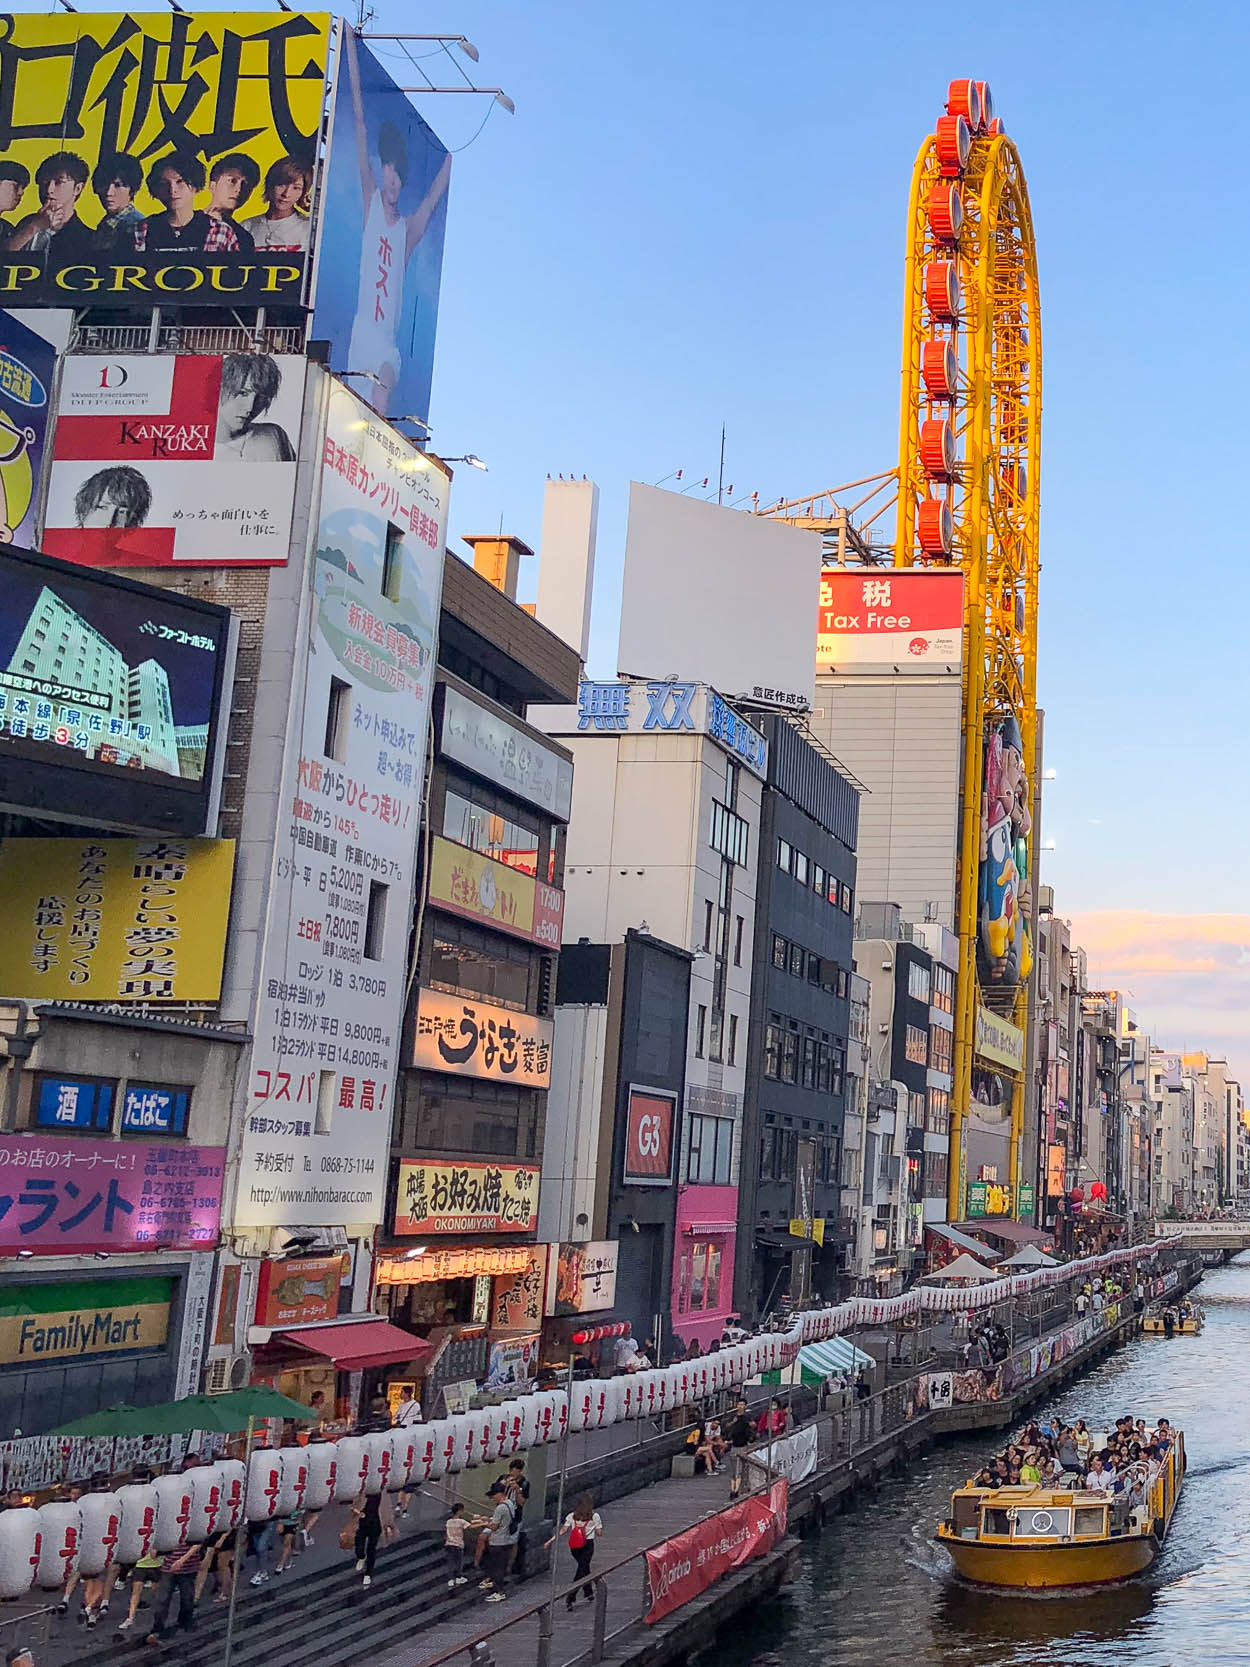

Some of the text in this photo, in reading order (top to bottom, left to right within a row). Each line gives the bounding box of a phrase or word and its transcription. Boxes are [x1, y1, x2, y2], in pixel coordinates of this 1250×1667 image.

[55, 264, 301, 292] GROUP
[118, 421, 209, 445] KANZAKI
[152, 438, 208, 457] RUKA
[323, 438, 439, 550] 日本原カンツリー倶楽部
[172, 508, 270, 521] めっちゃ面白いを
[240, 523, 280, 536] 仕事に。
[825, 612, 911, 629] Tax Free
[158, 624, 216, 651] ファーストホテル
[344, 639, 371, 673] 入会金
[577, 682, 697, 730] 無双
[752, 686, 807, 703] 意匠作成中
[330, 865, 364, 896] 5,200円
[68, 845, 107, 985] あなたのお店づくり
[540, 888, 560, 912] 17:00
[30, 895, 66, 974] 応援します
[119, 842, 188, 998] 素晴らしい夢の実現
[297, 914, 360, 945] 土日祝 7,800円
[299, 962, 387, 998] ロッジ 1泊 3,780円
[320, 1016, 339, 1037] 平日
[438, 1006, 521, 1074] うなぎ
[317, 1042, 336, 1063] 平日
[522, 1038, 549, 1074] 菱富
[56, 1085, 79, 1122] 酒
[254, 1070, 388, 1111] コスパ 最高!
[124, 1092, 169, 1126] たばこ
[249, 1116, 311, 1137] 幹部スタッフ募集
[638, 1115, 660, 1156] G3
[254, 1152, 295, 1173] 予約受付
[321, 1156, 375, 1173] 0868-75-1144
[406, 1169, 425, 1197] 本場
[429, 1167, 502, 1214] お好み焼
[0, 1178, 135, 1235] ラント
[409, 1195, 428, 1224] 大阪
[502, 1191, 531, 1226] たこ焼
[434, 1216, 497, 1231] OKONOMIYAKI
[526, 1258, 541, 1319] お好み焼
[19, 1312, 141, 1353] FamilyMart
[931, 1381, 950, 1401] 千房
[668, 1558, 691, 1585] airbnb
